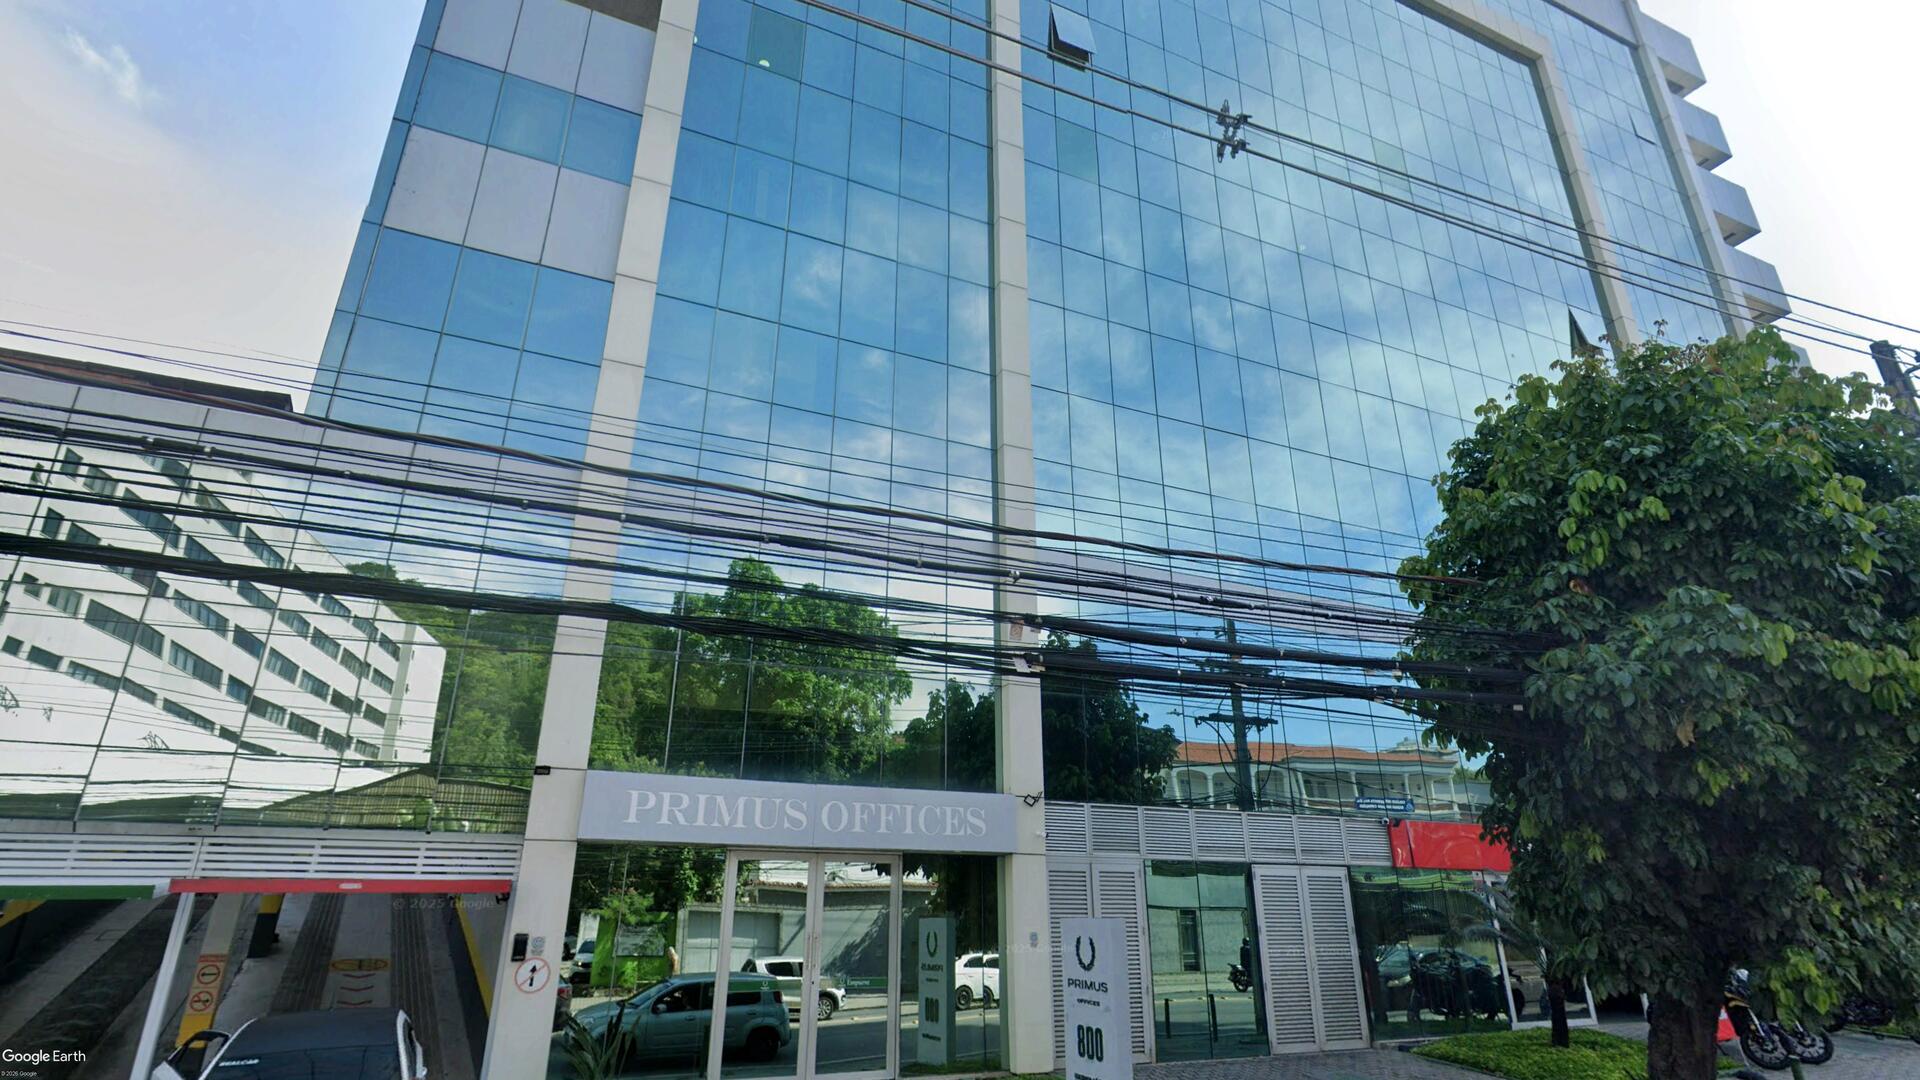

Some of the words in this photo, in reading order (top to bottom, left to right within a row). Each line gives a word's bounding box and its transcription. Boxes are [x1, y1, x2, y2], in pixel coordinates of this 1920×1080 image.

[623, 789, 808, 830] PRIMUS
[821, 800, 987, 837] OFFICES
[1067, 978, 1109, 993] PRIMUS
[1077, 1024, 1104, 1062] 800
